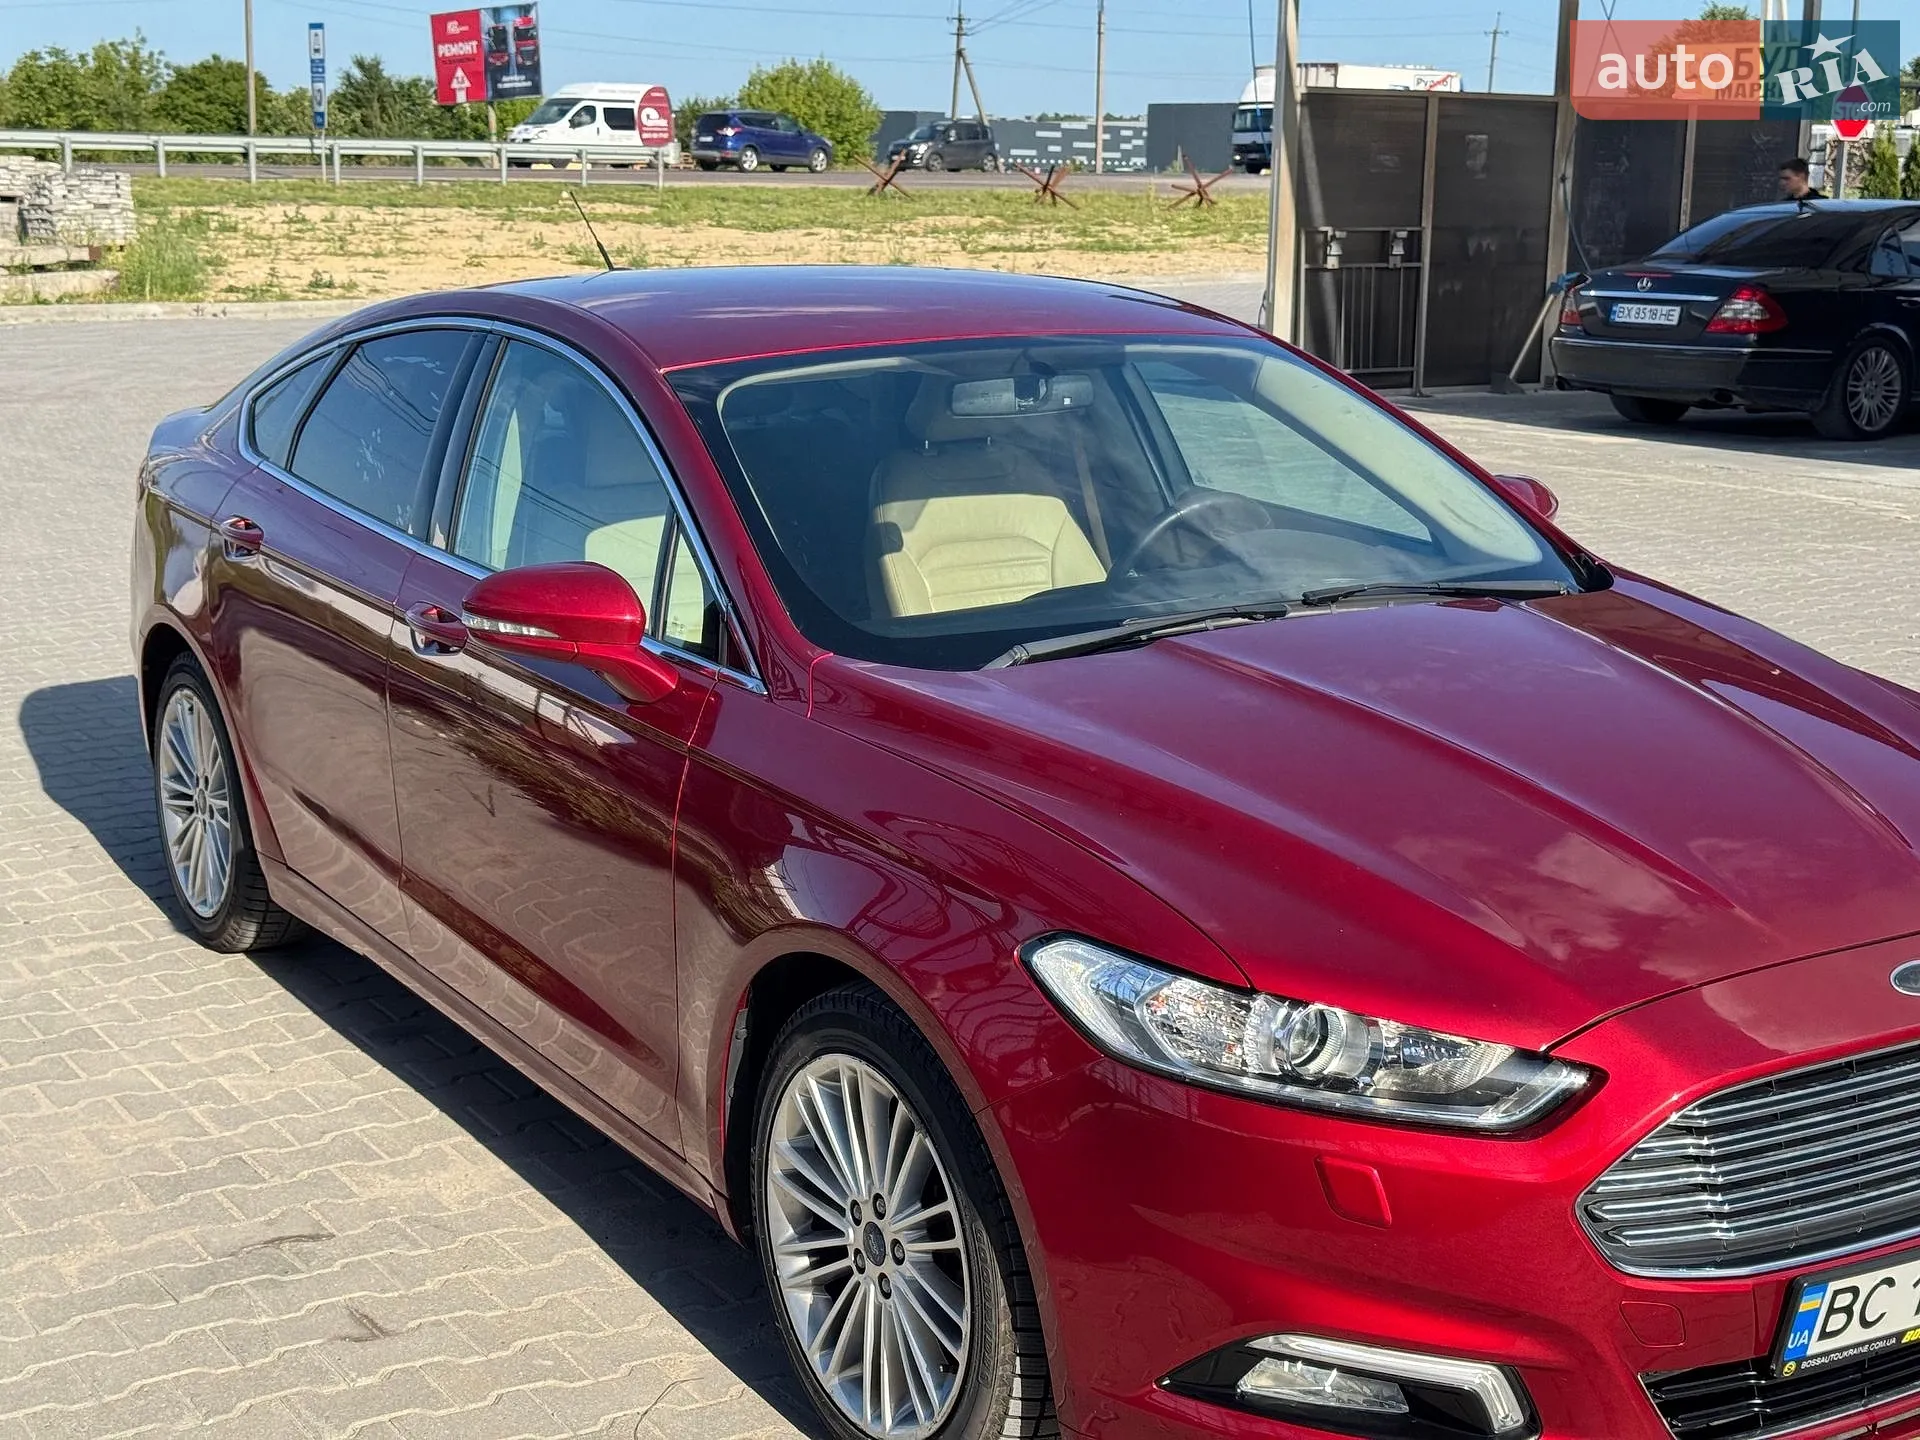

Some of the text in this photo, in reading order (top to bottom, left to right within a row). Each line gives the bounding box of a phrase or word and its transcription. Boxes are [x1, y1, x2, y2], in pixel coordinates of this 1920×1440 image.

[437, 39, 479, 58] РЕМОНТ
[1416, 77, 1449, 87] Рудо
[1617, 306, 1677, 322] BX 8518 HE
[1817, 1276, 1897, 1342] BC
[1787, 1329, 1809, 1349] UA
[1800, 1337, 1898, 1370] BOSSAUTOUKRAINE.COM.UA
